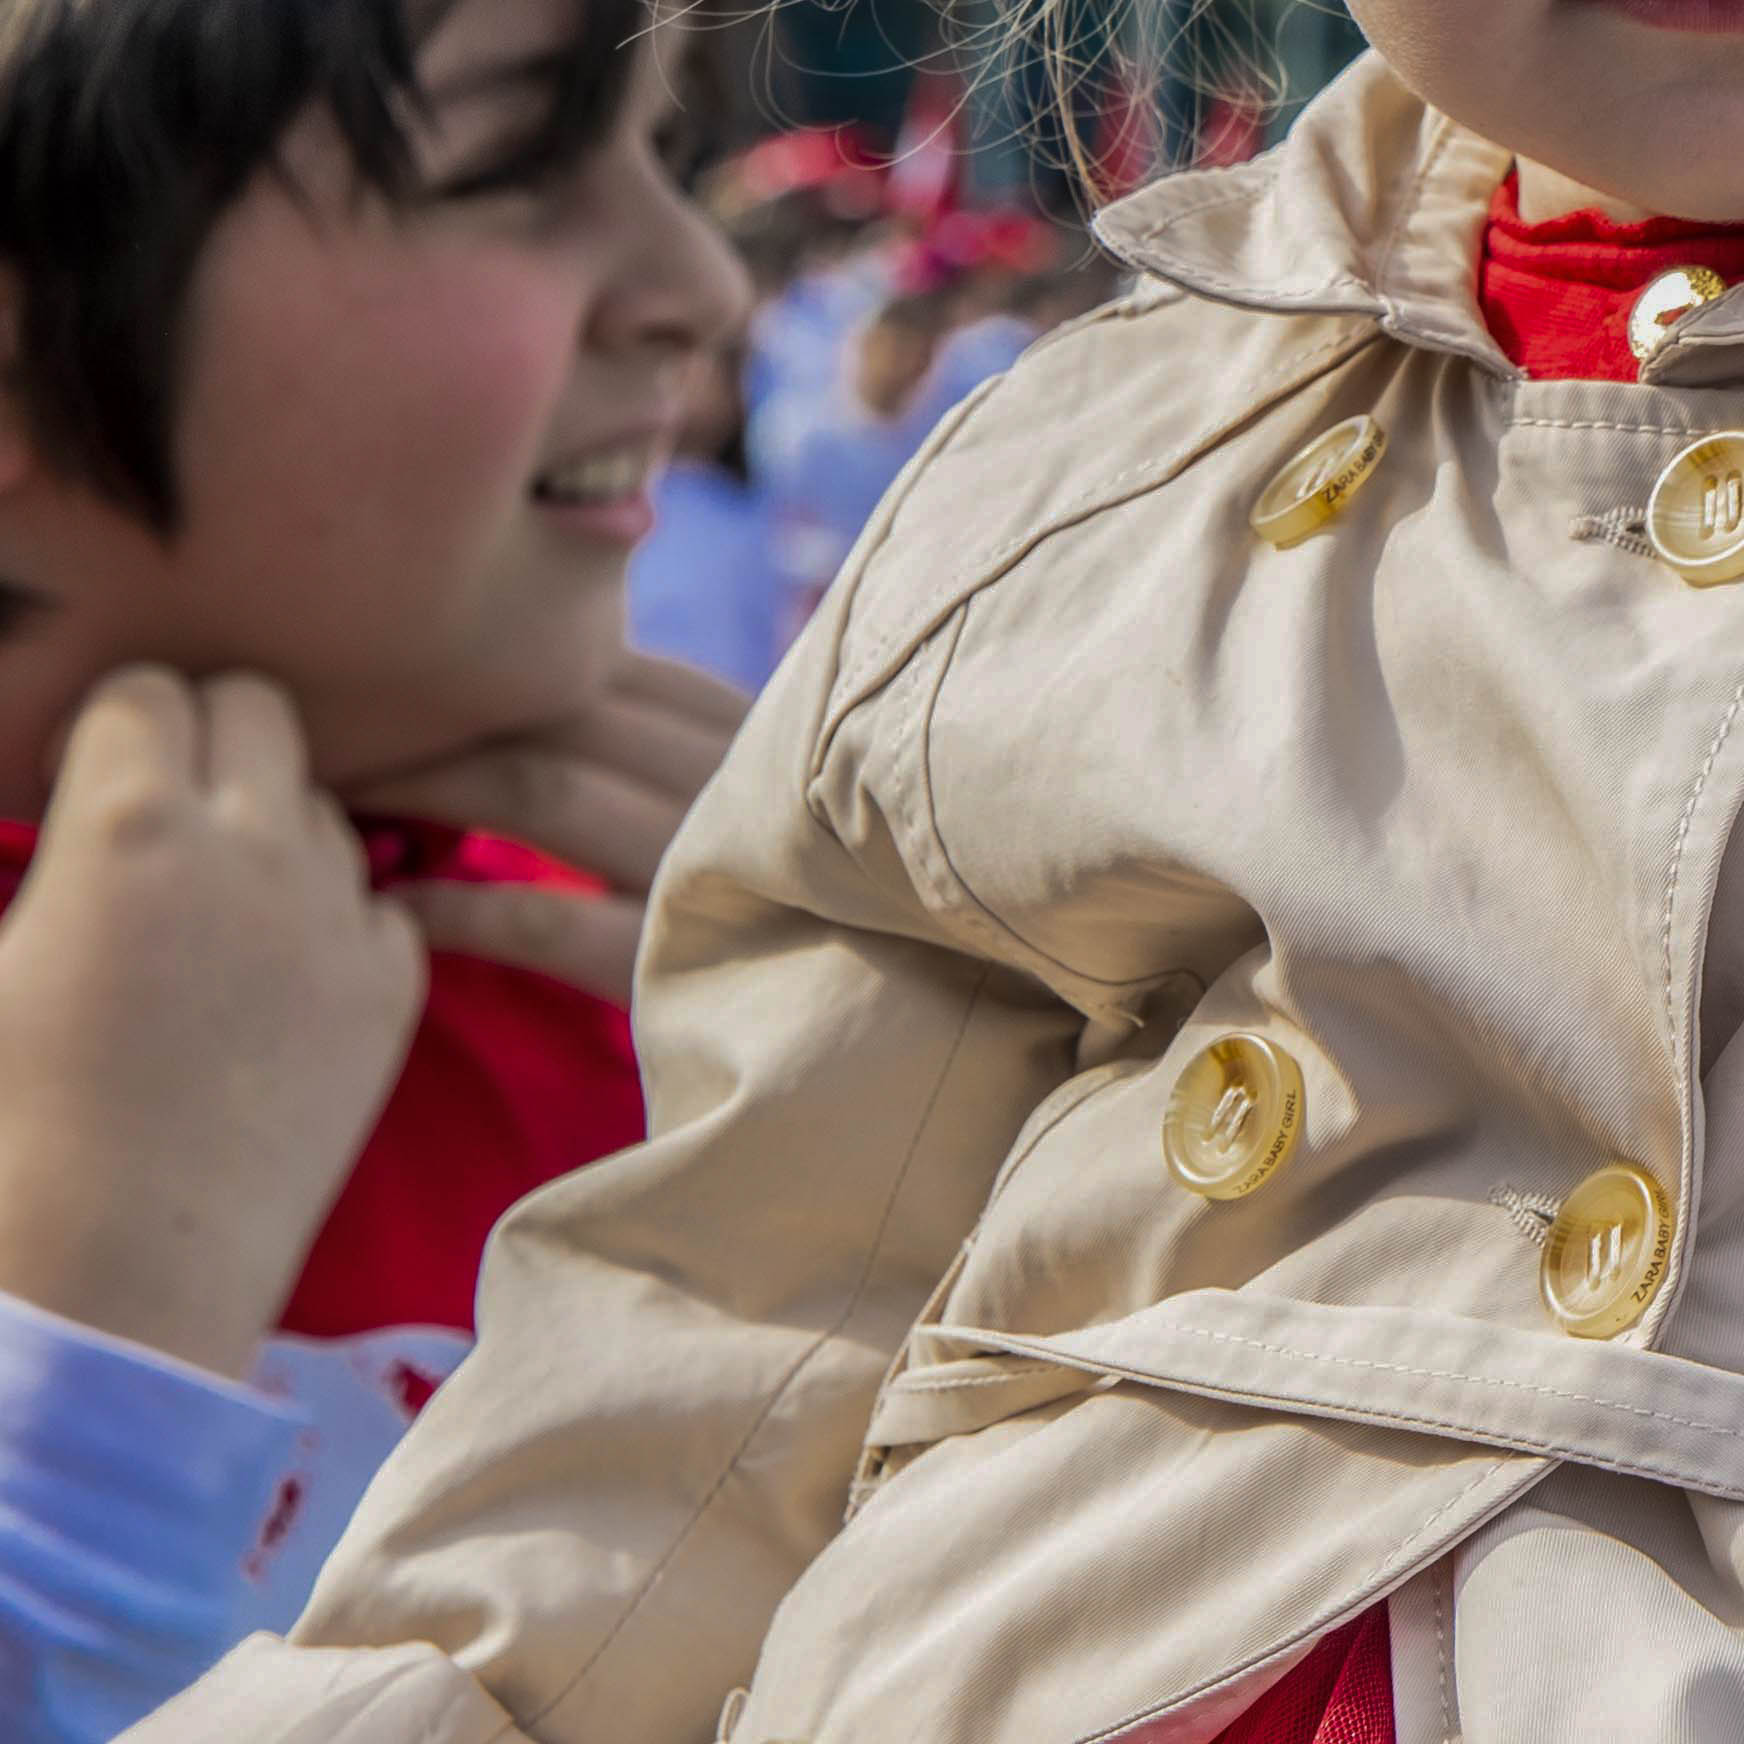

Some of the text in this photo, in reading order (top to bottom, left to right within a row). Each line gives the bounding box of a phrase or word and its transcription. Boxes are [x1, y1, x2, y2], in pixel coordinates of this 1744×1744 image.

[1231, 1089, 1296, 1193] ZARA BABY GIRL
[1630, 1261, 1663, 1303] ZARA
[1654, 1219, 1671, 1258] BABY
